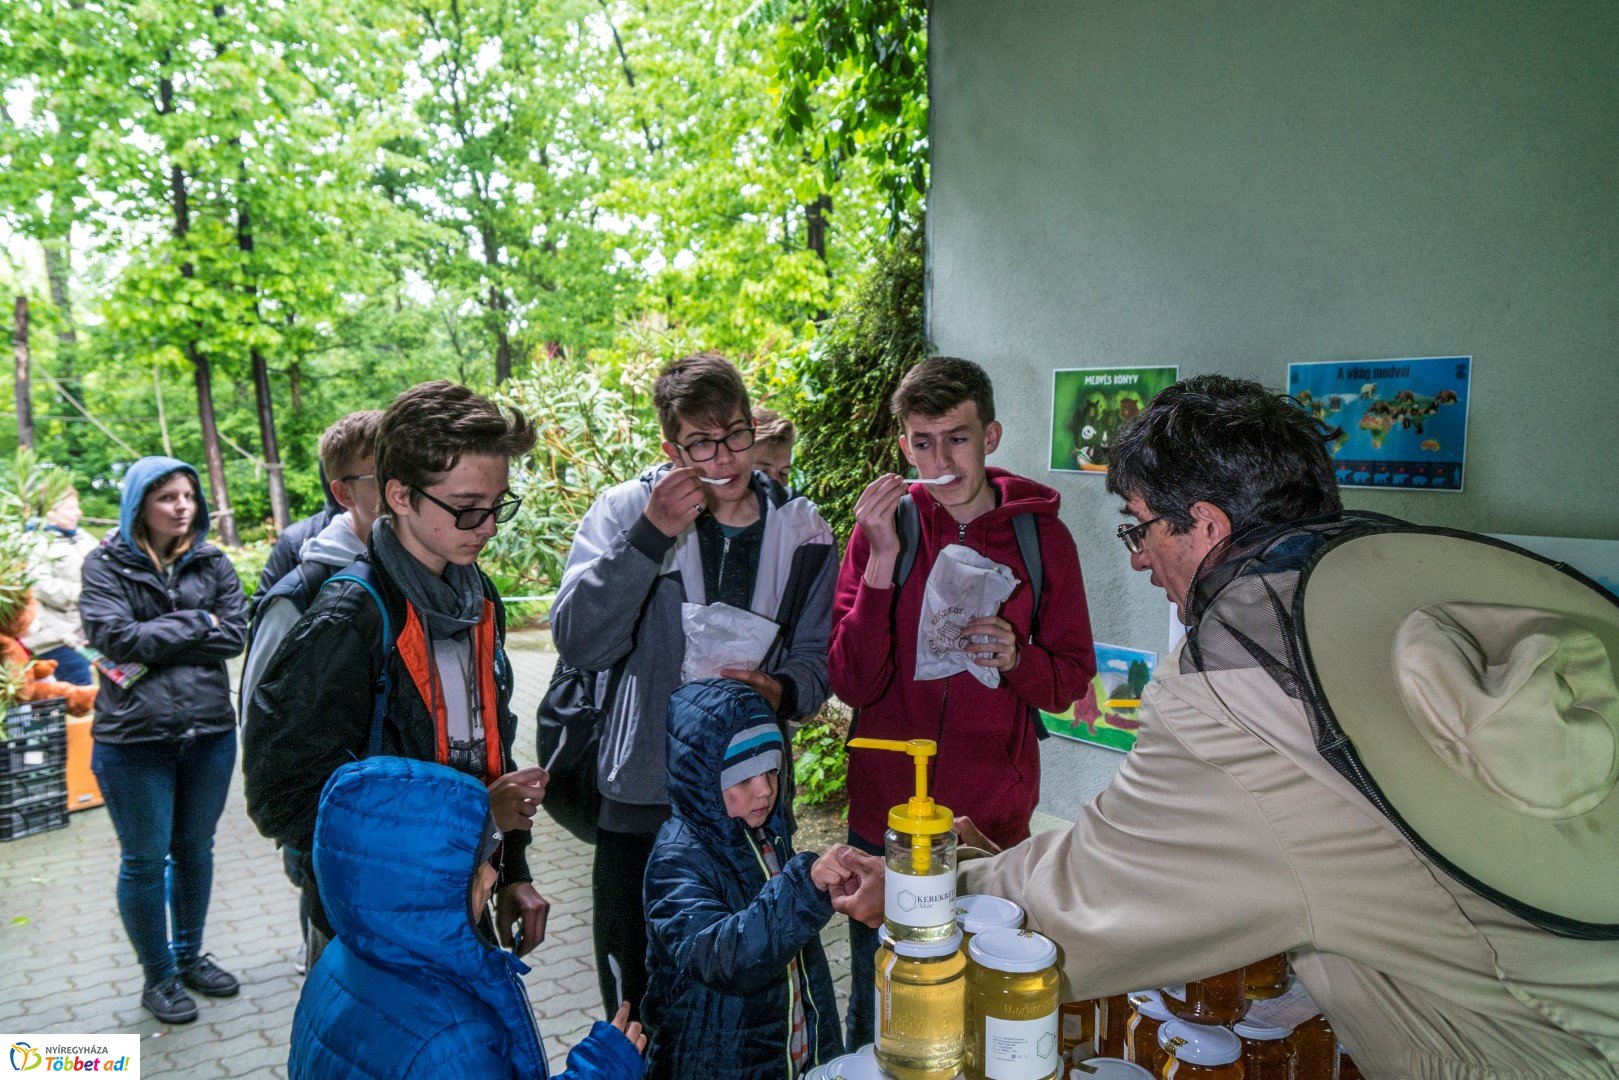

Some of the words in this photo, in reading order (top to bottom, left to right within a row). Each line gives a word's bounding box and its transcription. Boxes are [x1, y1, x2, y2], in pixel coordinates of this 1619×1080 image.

[1084, 373, 1112, 386] MEDVÉS
[1113, 374, 1139, 385] KÖNYV
[1337, 367, 1344, 380] A
[1347, 366, 1371, 380] világ
